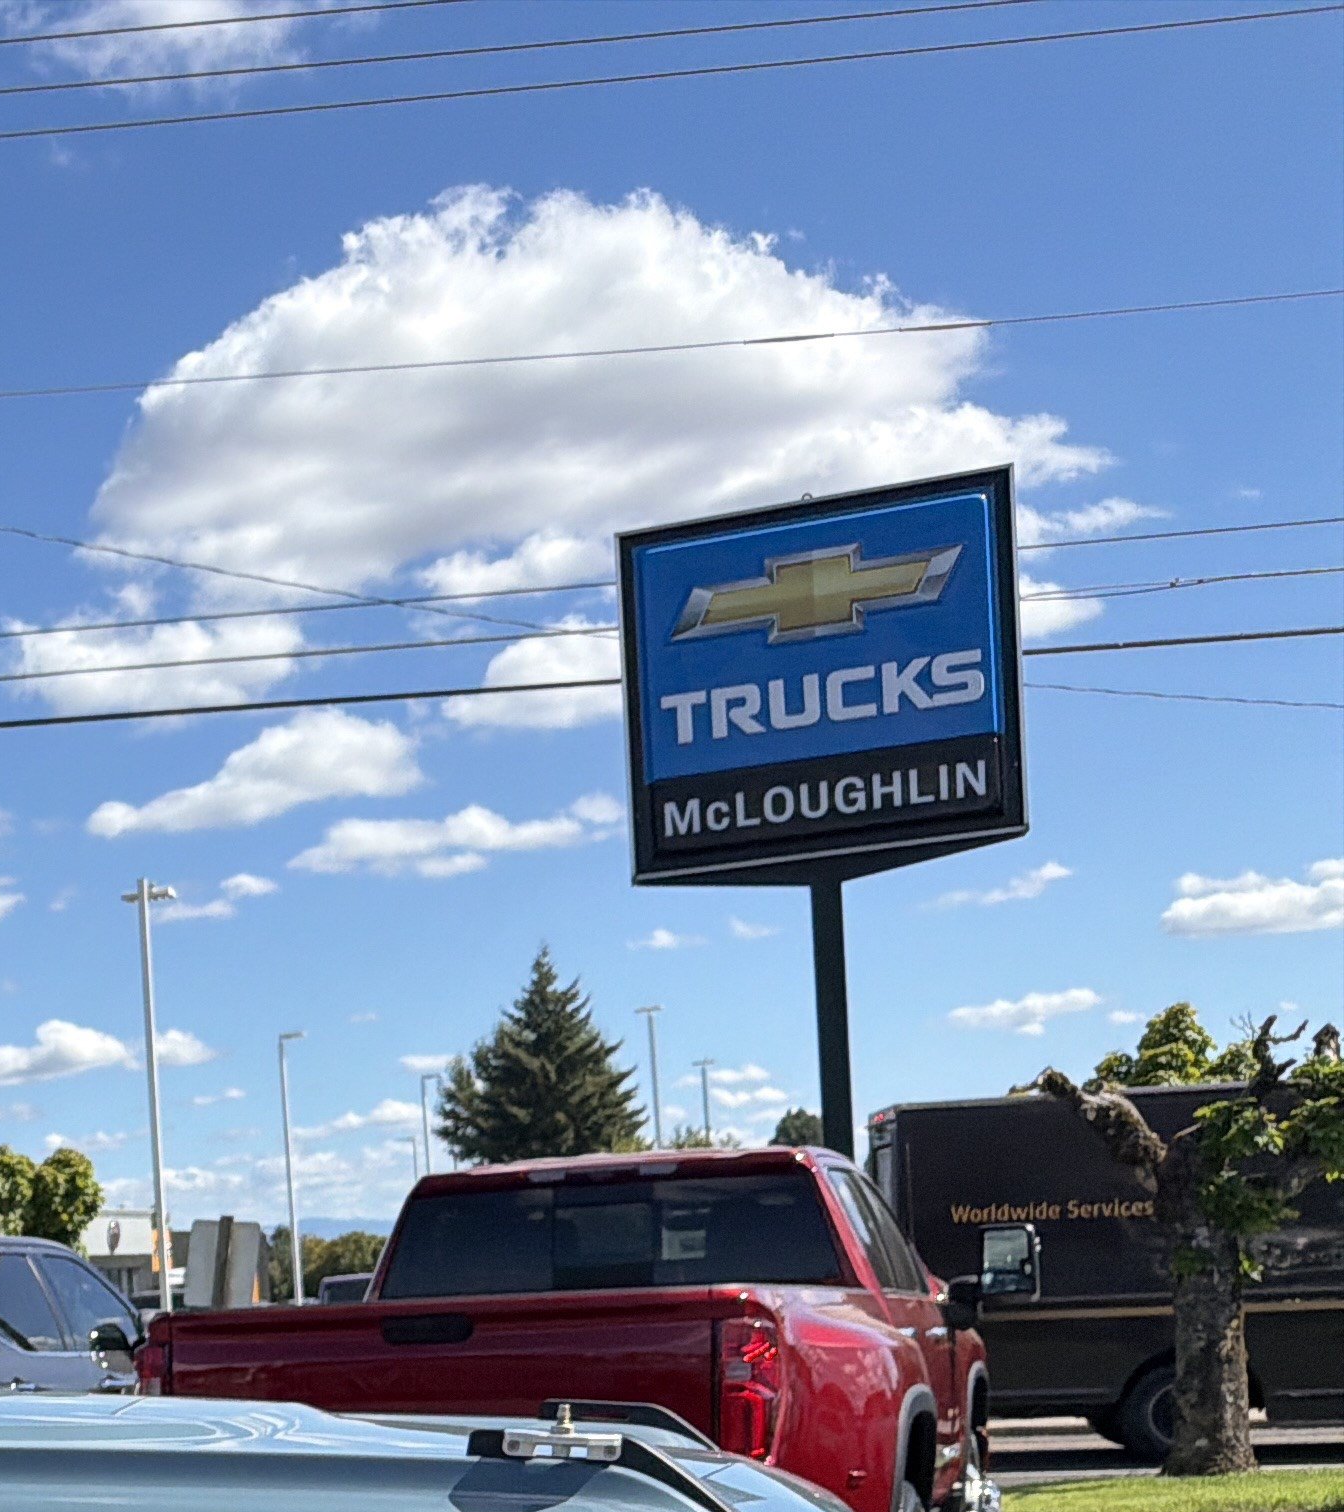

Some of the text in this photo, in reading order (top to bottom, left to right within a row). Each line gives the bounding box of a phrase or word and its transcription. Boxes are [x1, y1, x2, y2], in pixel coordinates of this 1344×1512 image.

[661, 648, 985, 743] TRUCKS
[664, 759, 987, 837] McLOUGHLIN
[950, 1198, 1155, 1224] Worldwide Services
